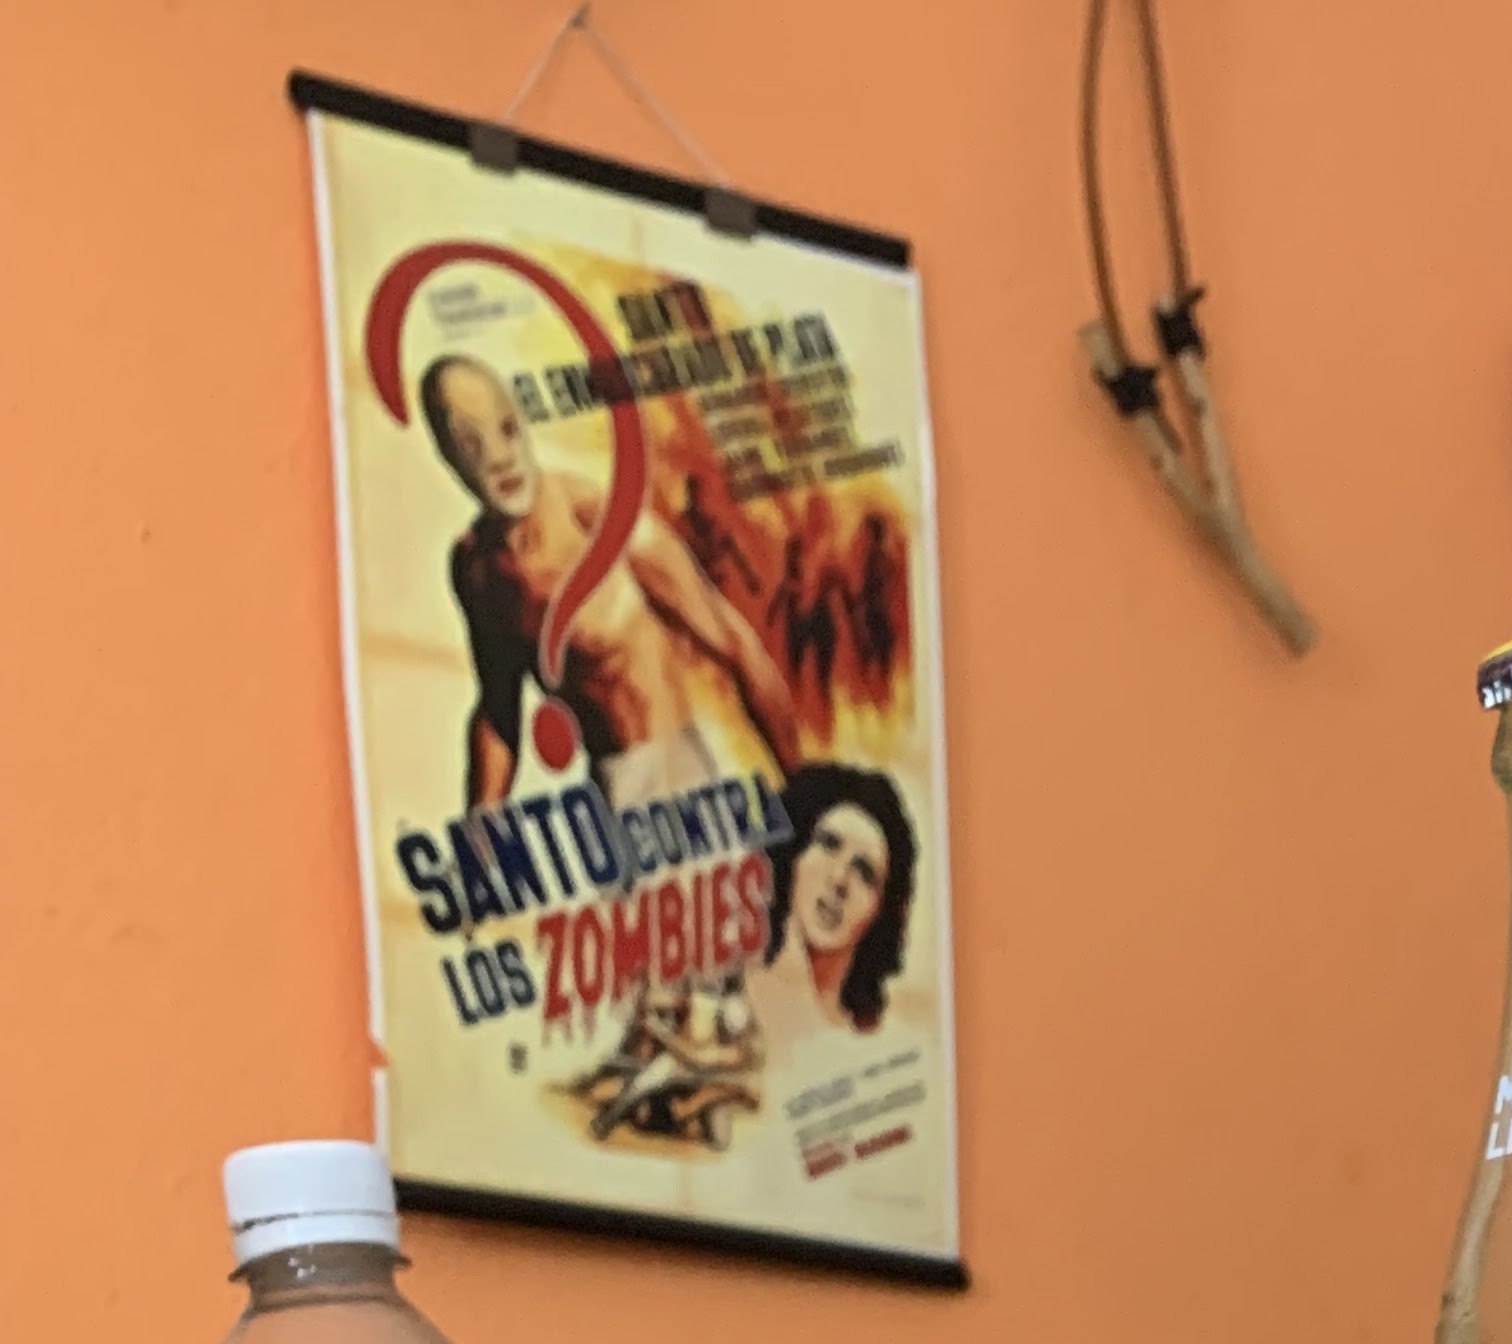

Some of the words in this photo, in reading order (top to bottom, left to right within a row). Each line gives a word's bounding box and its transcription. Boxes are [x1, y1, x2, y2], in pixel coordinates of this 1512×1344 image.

[396, 785, 619, 934] SANTO
[622, 773, 795, 872] CONTRA
[441, 941, 538, 1027] LOS
[536, 850, 772, 1022] ZOMBIES
